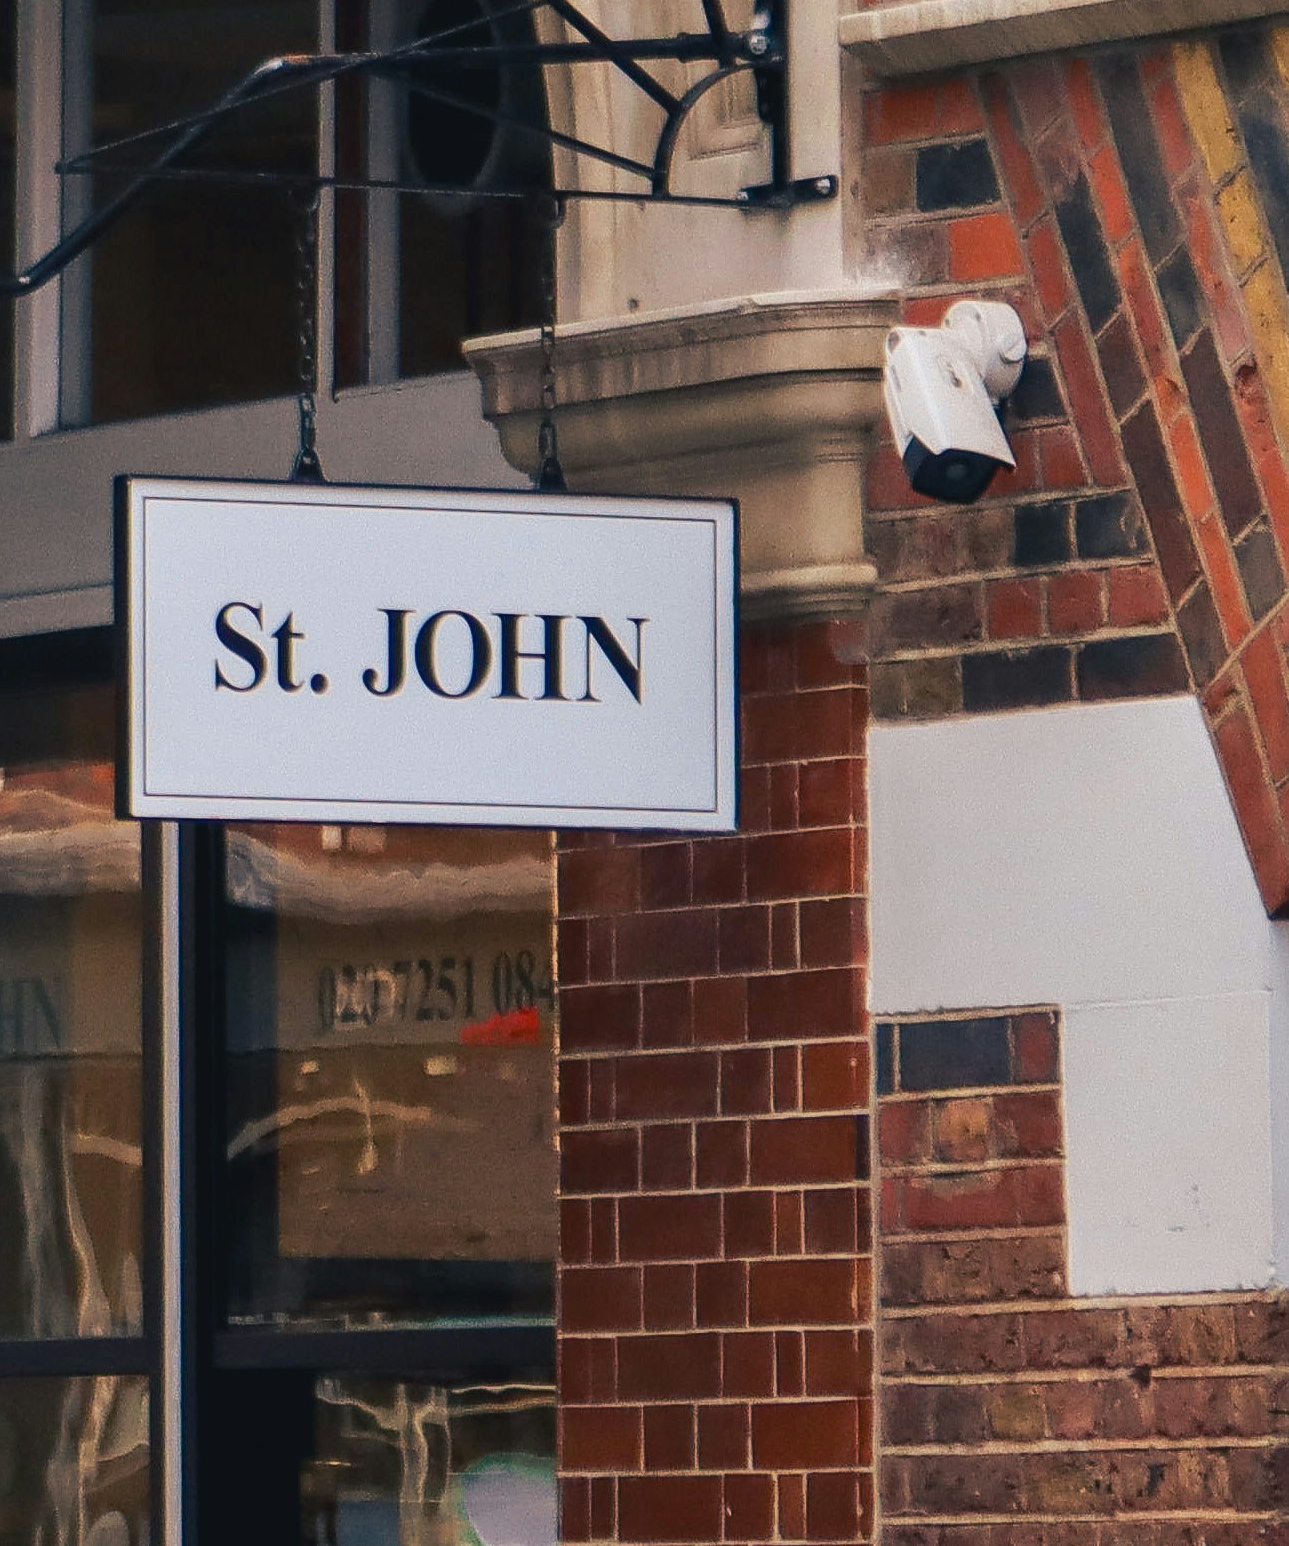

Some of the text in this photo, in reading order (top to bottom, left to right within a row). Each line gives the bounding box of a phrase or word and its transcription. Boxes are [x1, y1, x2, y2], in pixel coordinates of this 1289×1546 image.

[214, 601, 651, 706] St. JOHN
[391, 956, 476, 1024] 7251
